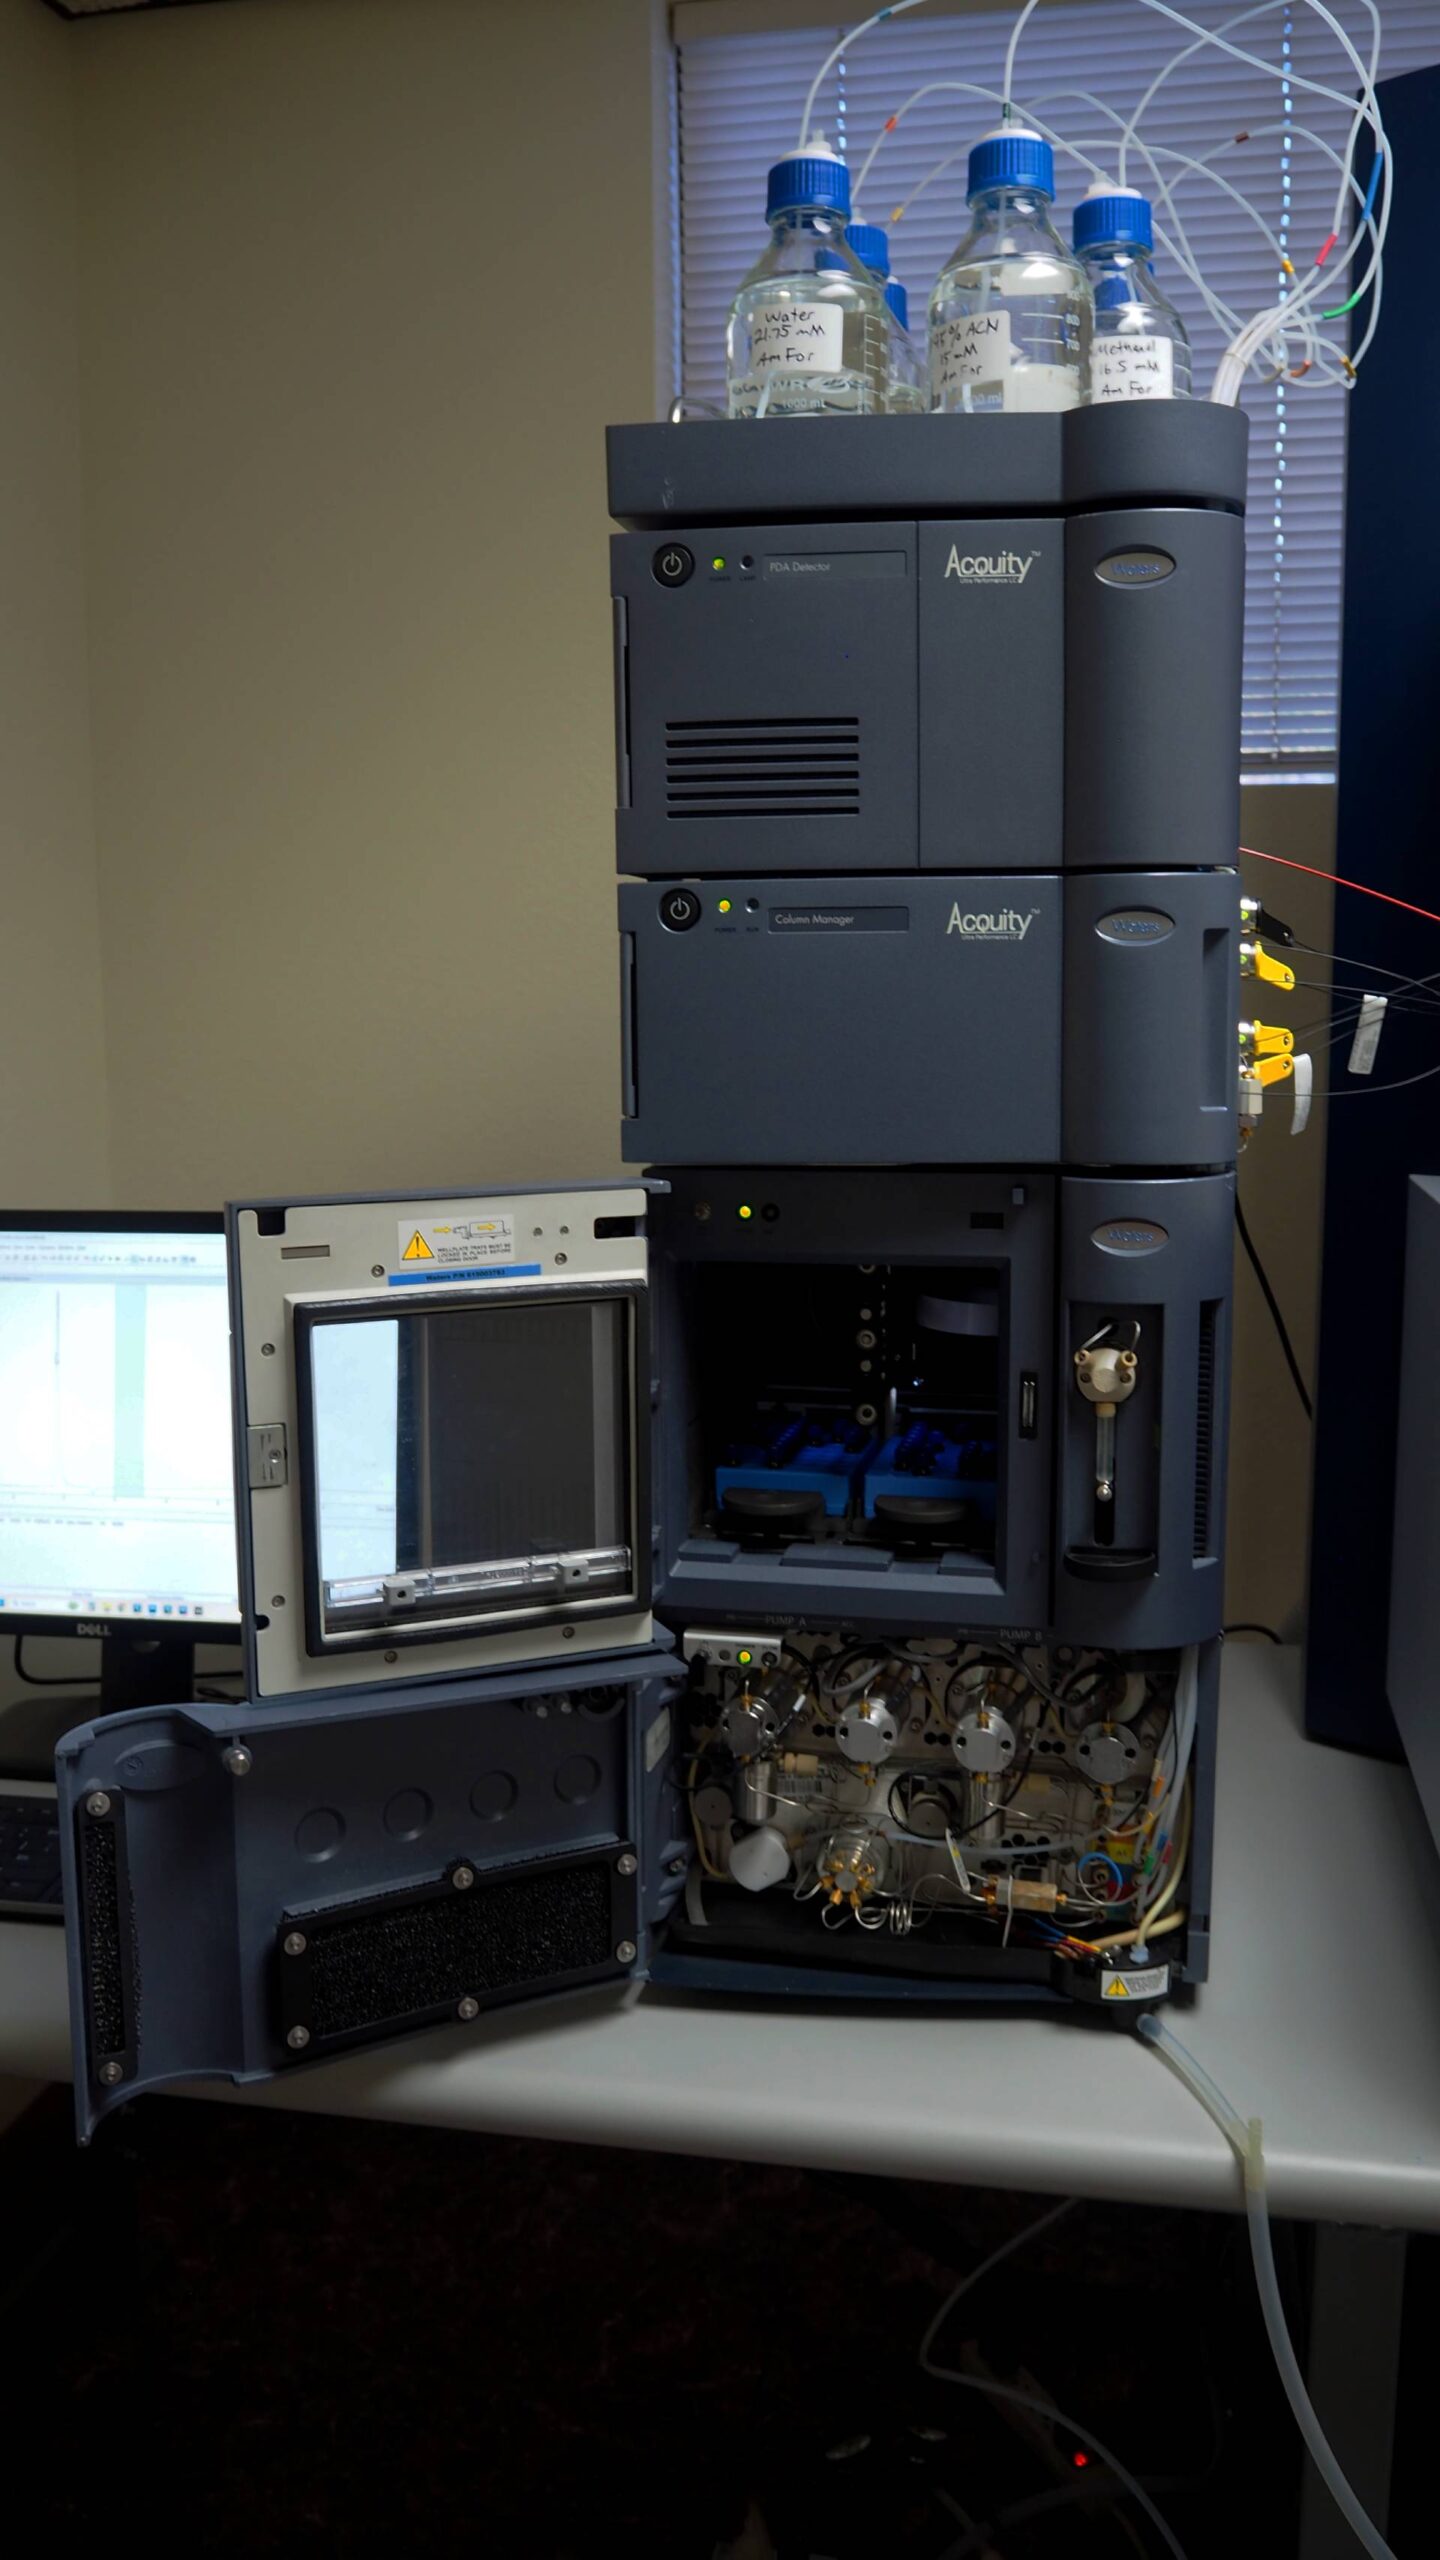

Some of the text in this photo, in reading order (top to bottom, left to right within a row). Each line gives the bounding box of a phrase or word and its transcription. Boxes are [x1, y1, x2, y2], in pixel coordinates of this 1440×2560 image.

[765, 307, 817, 323] Water
[754, 324, 791, 345] 21.75
[966, 318, 999, 337] ACN
[786, 347, 814, 362] For
[769, 561, 830, 572] PDA Detector
[944, 543, 1033, 583] Acquity
[775, 913, 855, 927] Column Manager
[946, 902, 1033, 940] Acquity
[765, 1614, 794, 1625] PUMP
[799, 1616, 807, 1626] A
[77, 1623, 112, 1636] DELL
[1000, 1628, 1031, 1640] PUMP
